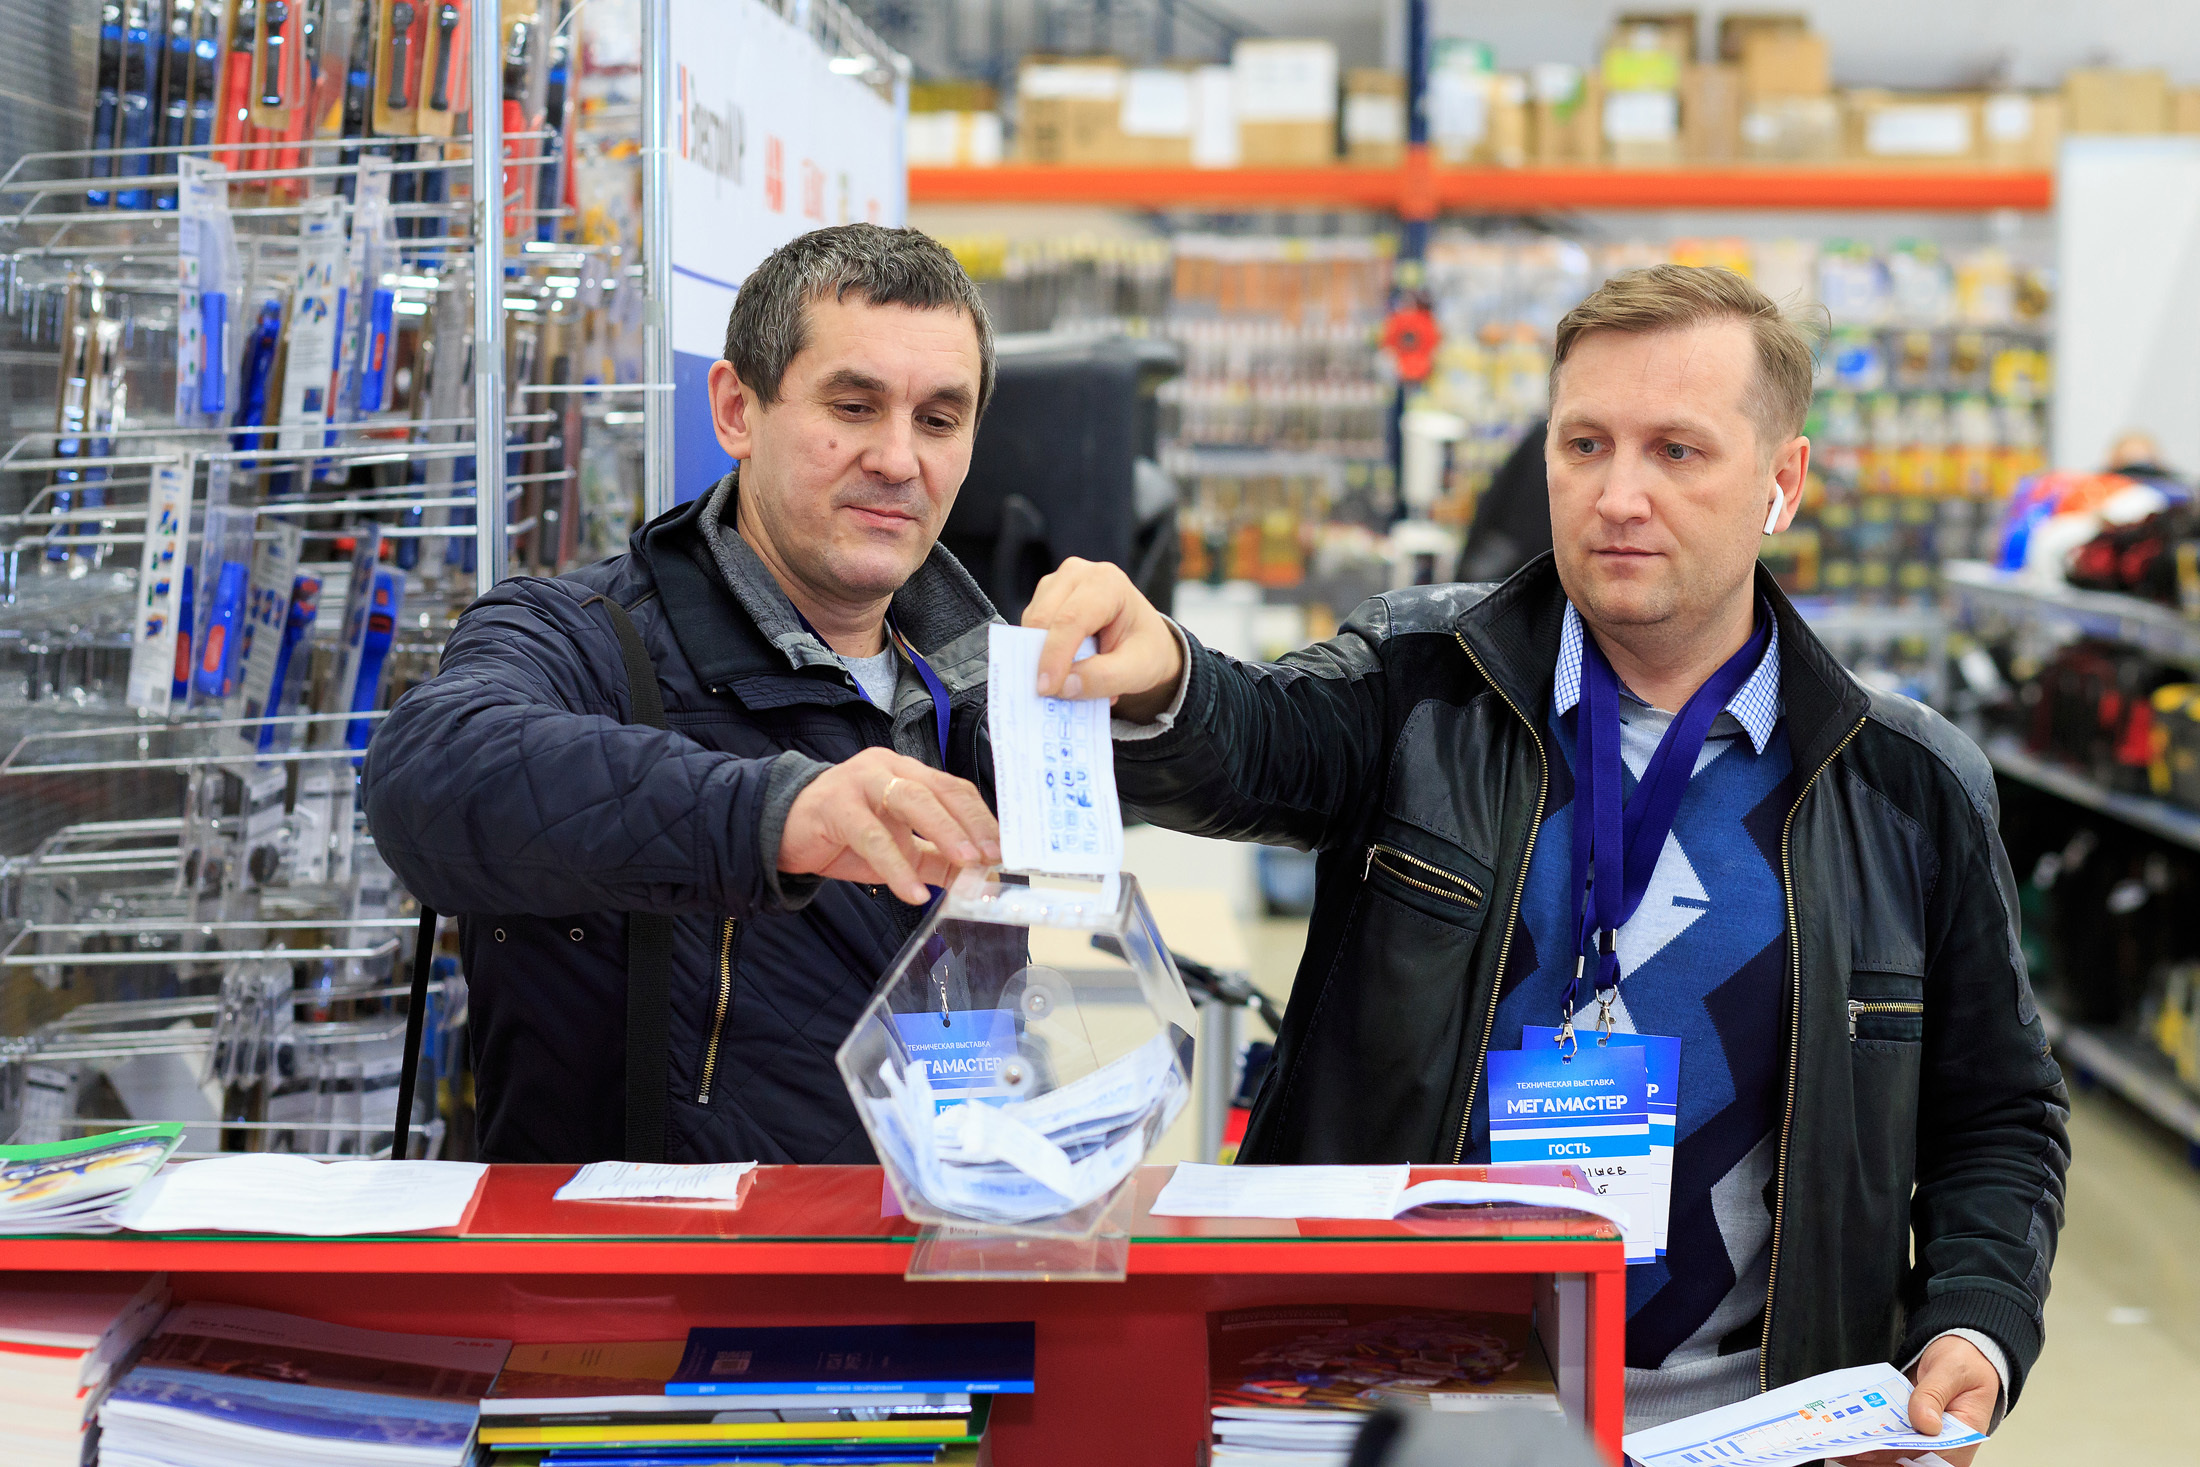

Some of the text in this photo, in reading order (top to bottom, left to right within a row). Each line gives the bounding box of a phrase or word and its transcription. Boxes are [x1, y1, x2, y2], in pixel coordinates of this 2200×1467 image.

[907, 1040, 991, 1051] ТЕХНИЧЕСКАЯ ВЫСТАВКА
[923, 1057, 1002, 1074] ГАМАСТЕР
[1516, 1078, 1615, 1089] ТЕХНИЧЕСКАЯ ВЫСТАВКА
[1507, 1095, 1628, 1114] МЕГАМАСТЕР
[1548, 1143, 1591, 1155] ГОСТЬ
